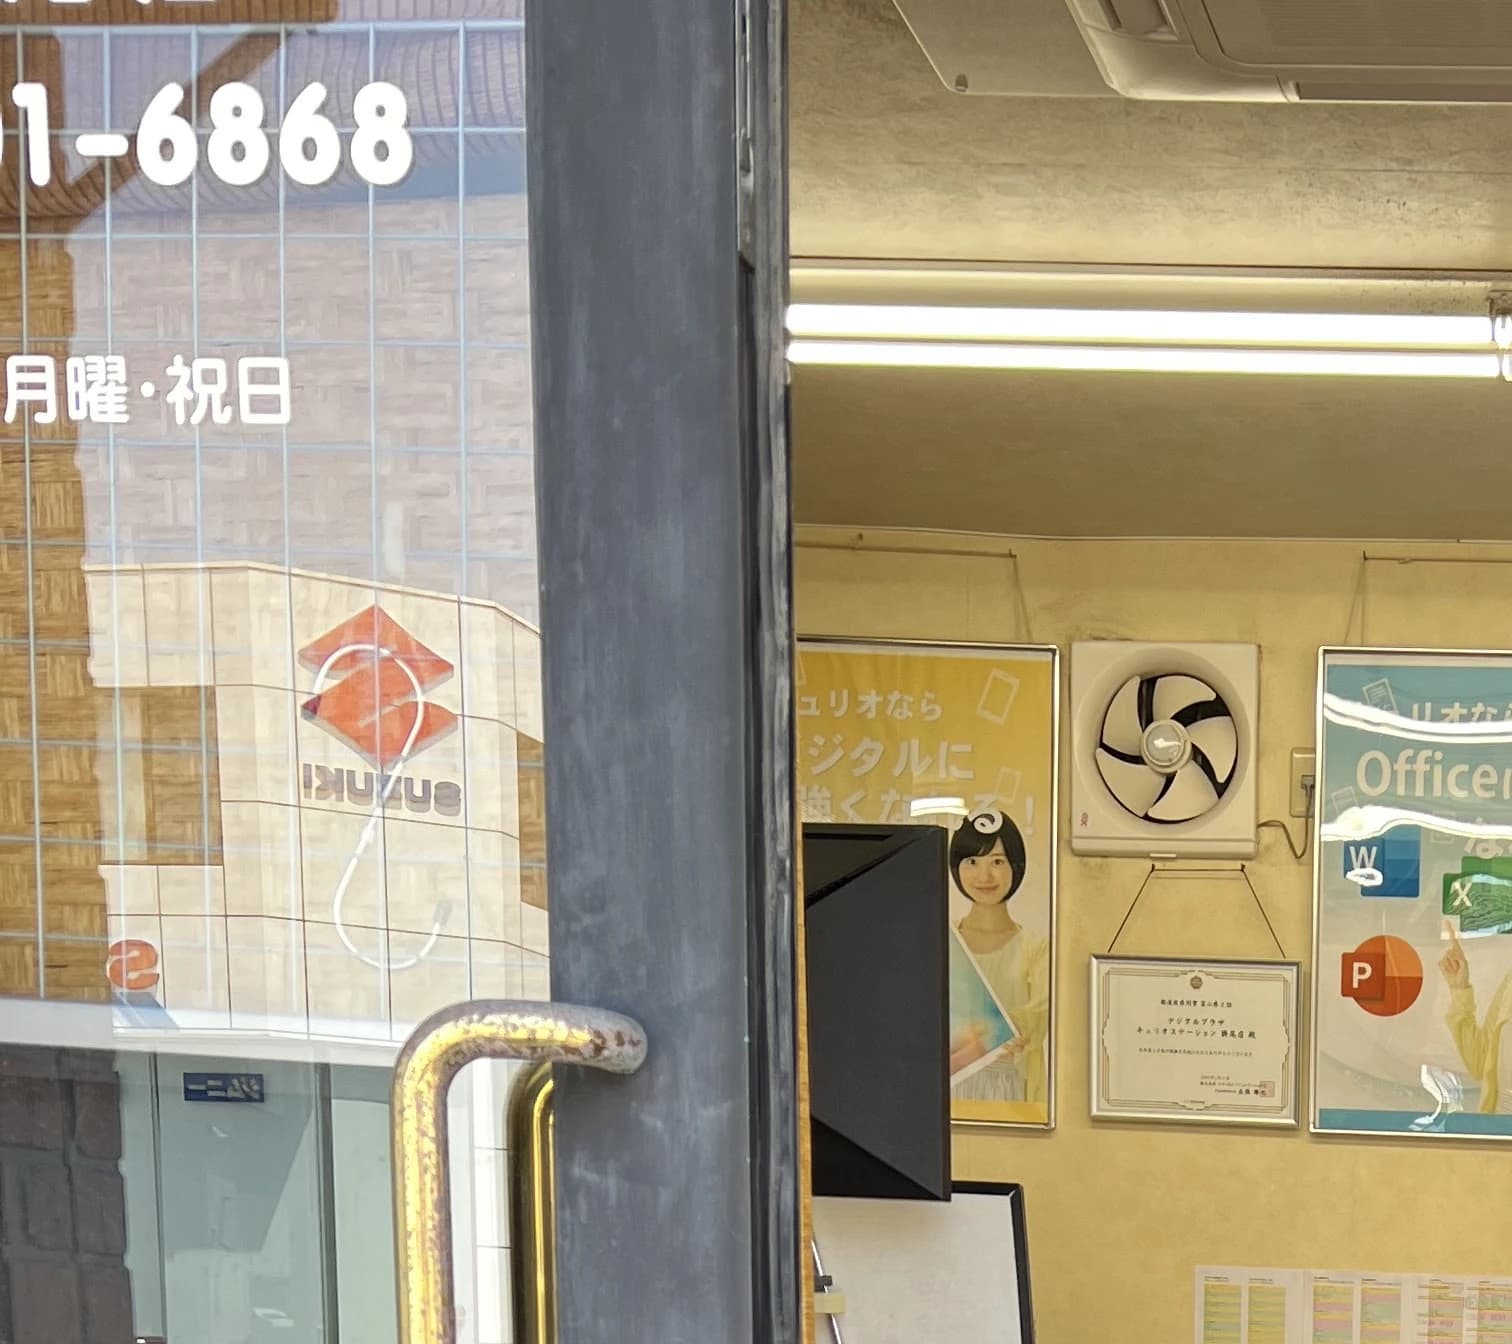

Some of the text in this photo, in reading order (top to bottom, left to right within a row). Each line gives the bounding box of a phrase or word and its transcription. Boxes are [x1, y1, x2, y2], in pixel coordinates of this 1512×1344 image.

[0, 81, 414, 187] 1-6868
[4, 354, 291, 425] 月曜・祝日
[808, 733, 975, 780] ジタルに
[1452, 881, 1472, 907] X
[1352, 962, 1372, 989] P
